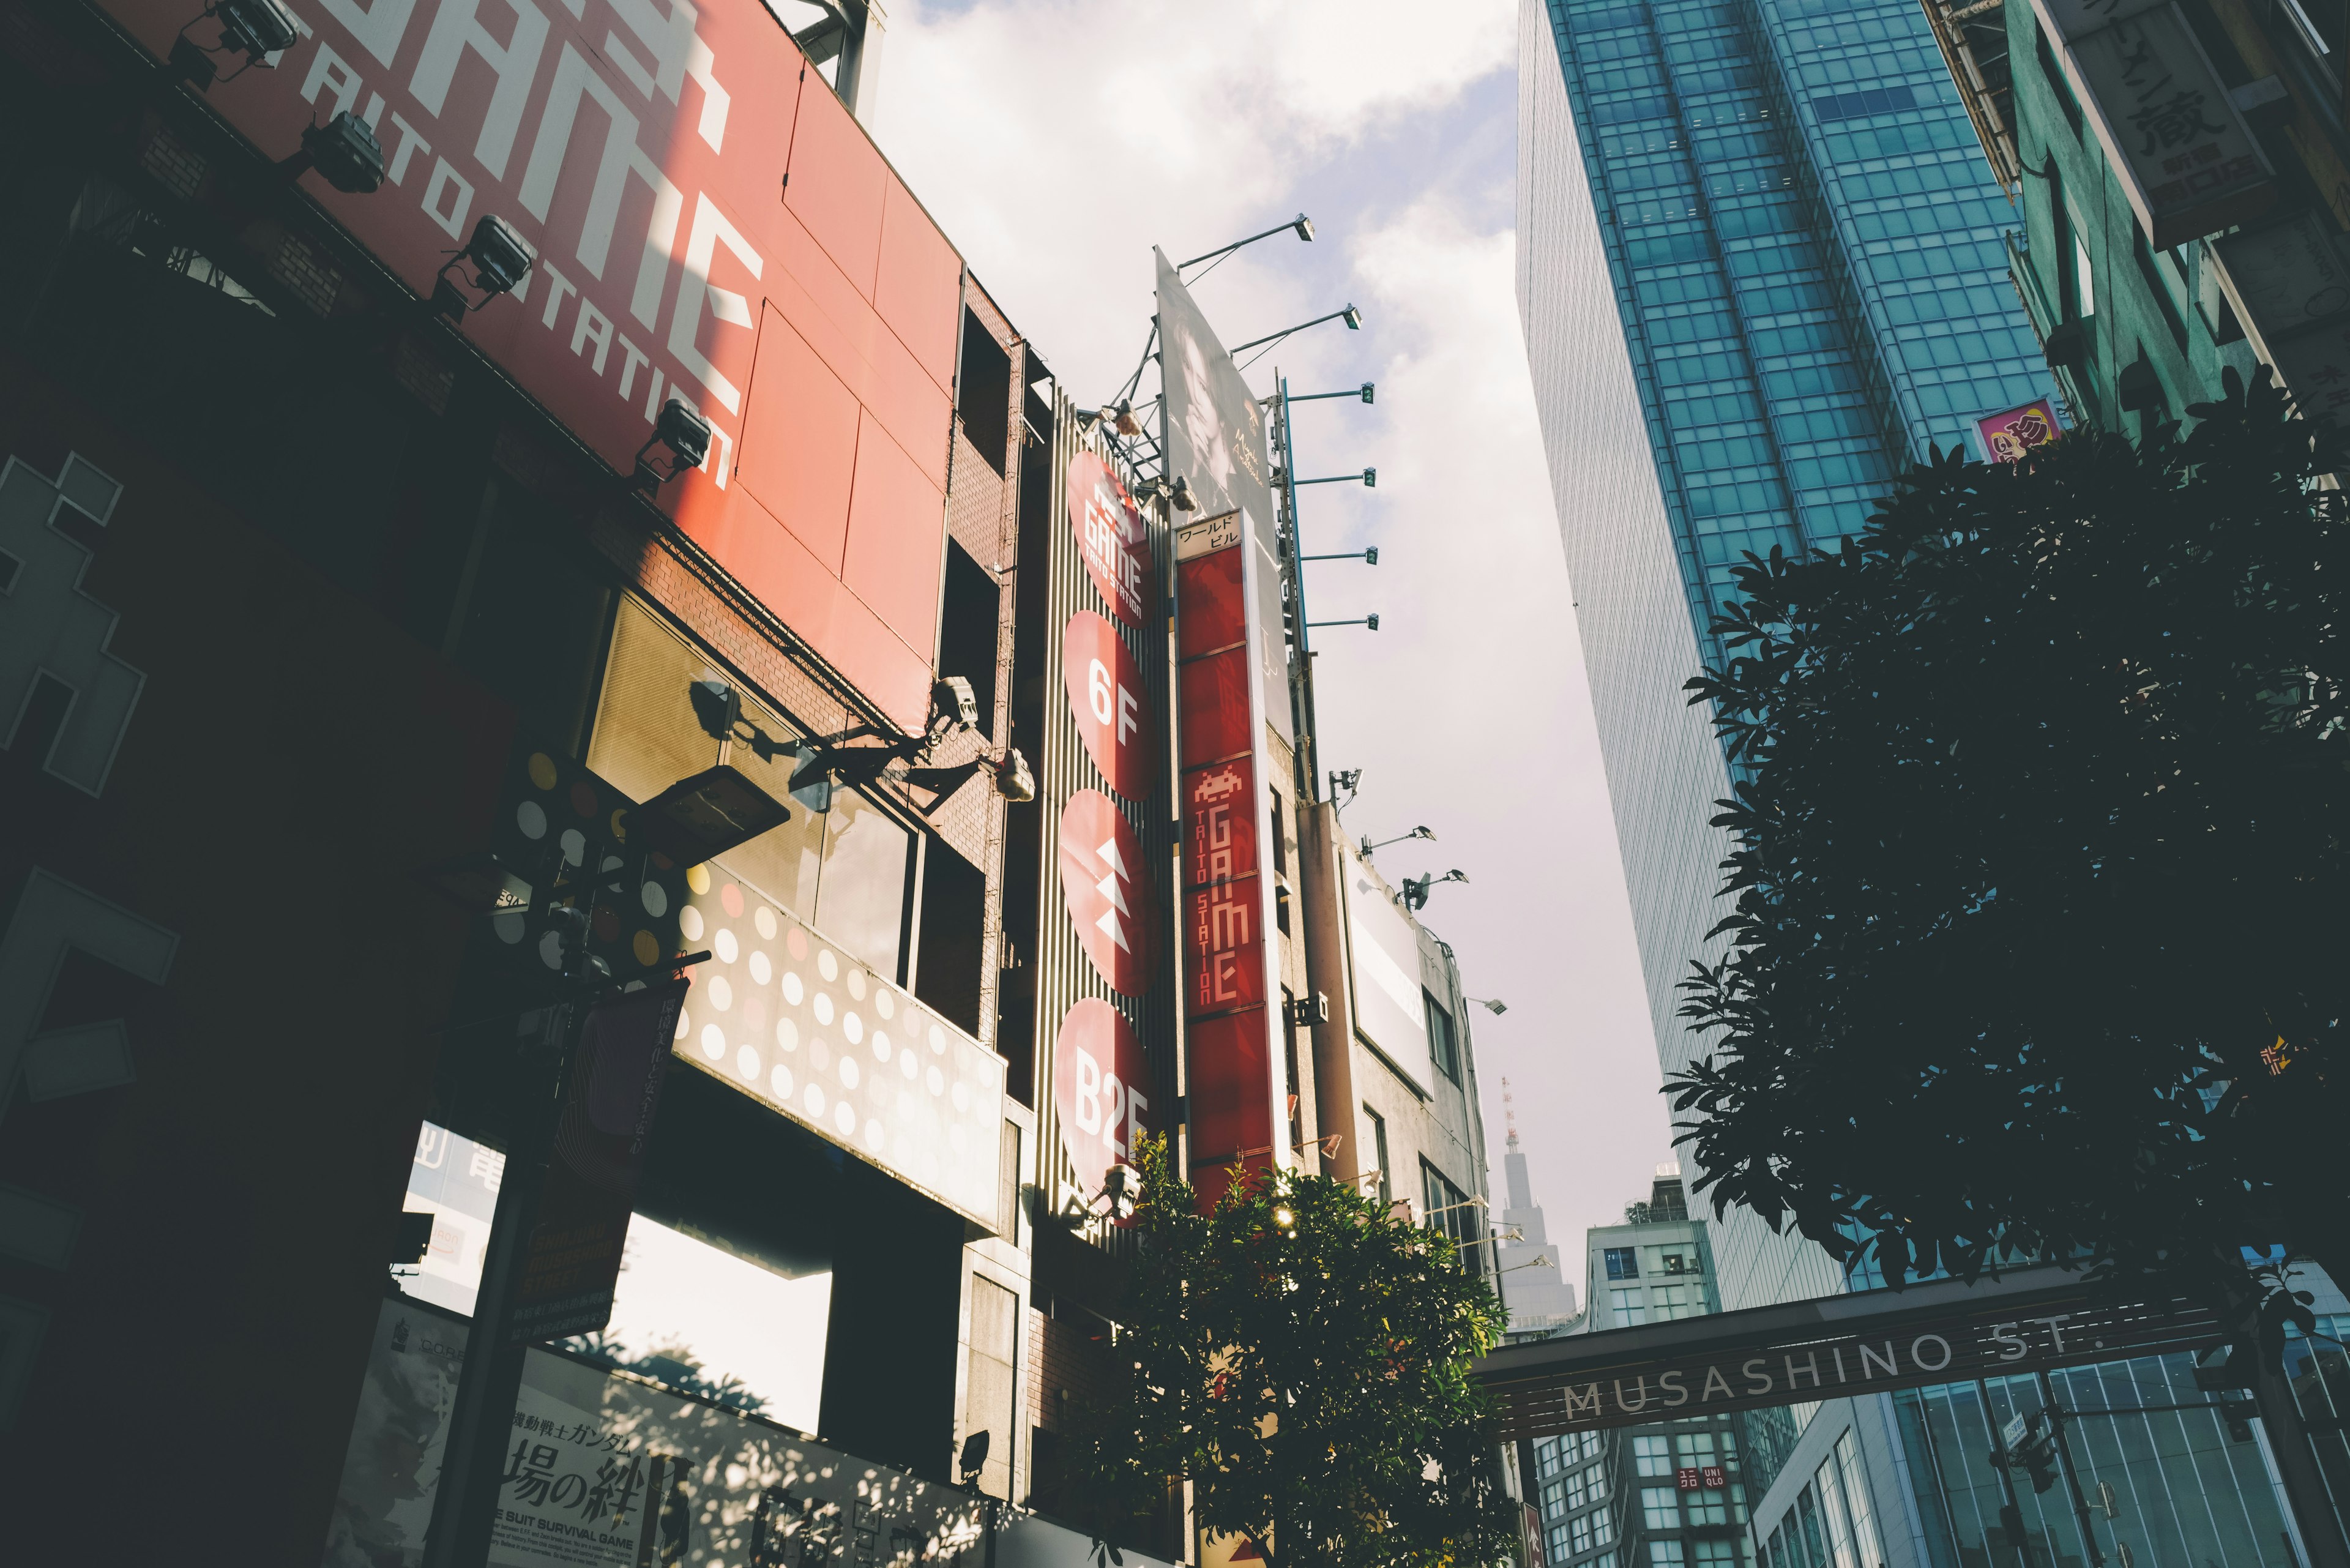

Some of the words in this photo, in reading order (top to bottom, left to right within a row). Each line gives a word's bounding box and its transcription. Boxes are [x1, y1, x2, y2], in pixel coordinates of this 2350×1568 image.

[1085, 498, 1141, 603] GAME
[1180, 516, 1233, 543] ワールド
[1211, 532, 1238, 548] ビル
[1084, 542, 1108, 581] TAITO
[1110, 572, 1141, 620] STATION
[1089, 658, 1137, 747] 6F
[1195, 810, 1206, 884] TAITO
[1209, 803, 1249, 1002] GAME
[1198, 893, 1210, 1006] STATION
[1075, 1045, 1148, 1167] B2F
[521, 1267, 582, 1294] STREET
[1562, 1334, 1952, 1420] MUSASHINO
[1993, 1315, 2105, 1362] ST.
[1704, 1468, 1721, 1477] UNI
[1706, 1477, 1723, 1487] QLO
[505, 1510, 536, 1527] SUIT
[537, 1518, 597, 1542] SURVIVAL
[599, 1533, 634, 1550] GAME
